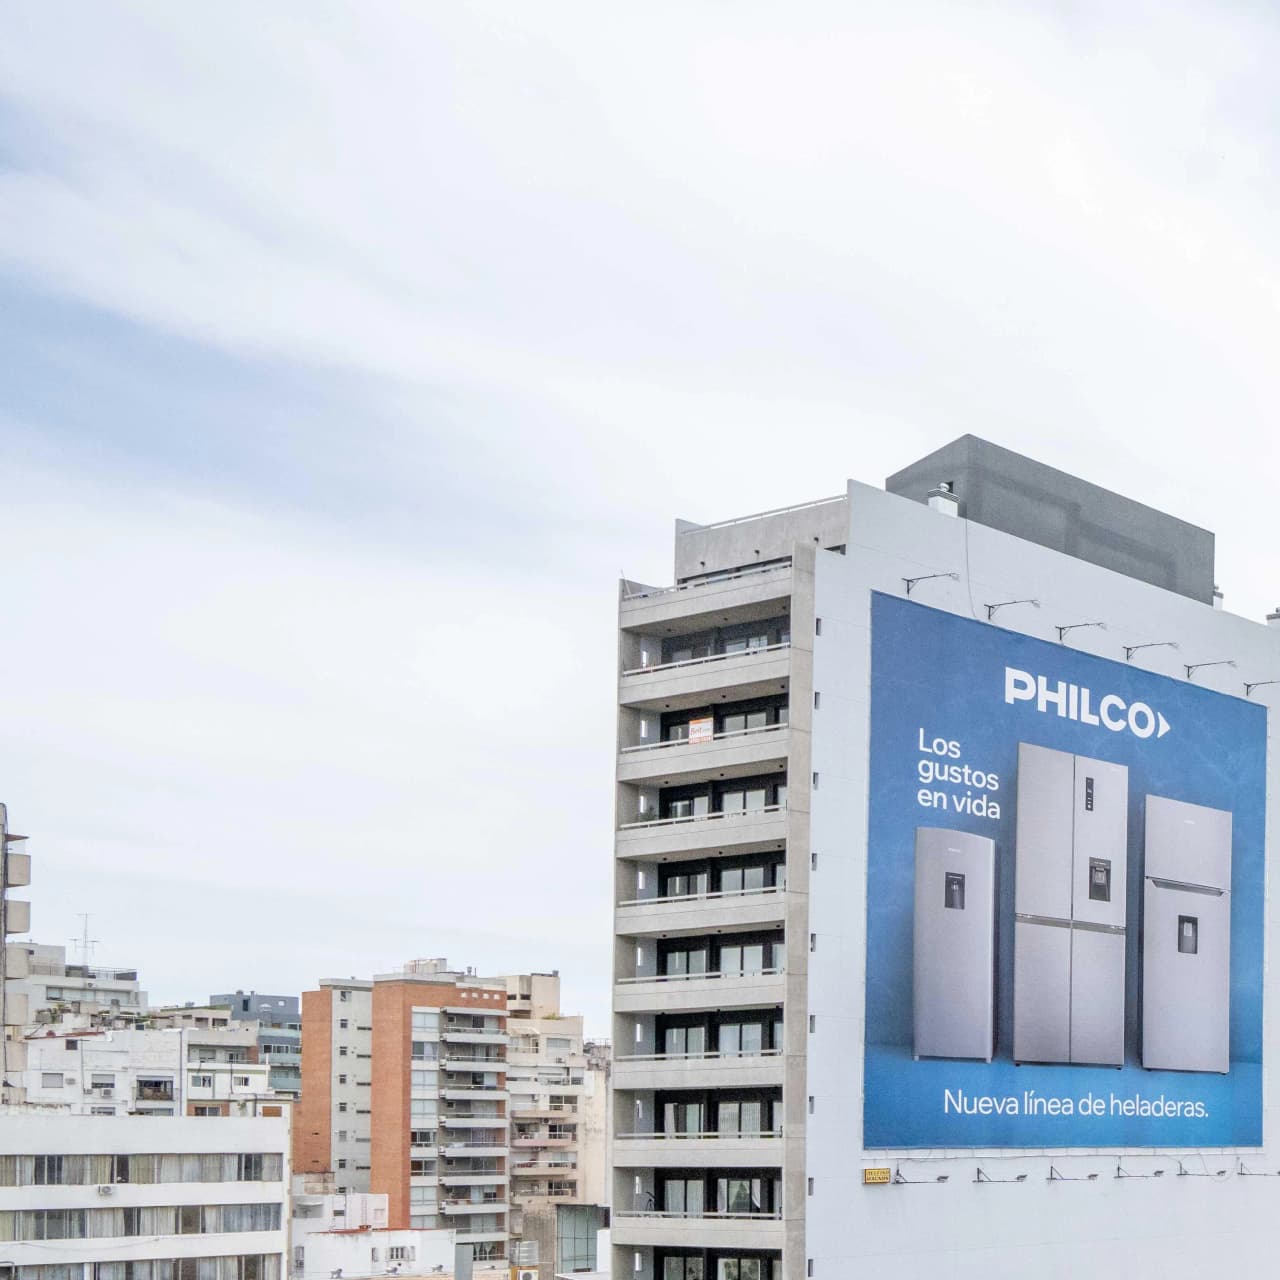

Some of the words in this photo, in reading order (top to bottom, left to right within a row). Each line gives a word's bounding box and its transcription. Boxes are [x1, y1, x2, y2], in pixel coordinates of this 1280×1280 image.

[1005, 666, 1156, 739] PHILCO
[919, 728, 960, 758] Los
[918, 760, 999, 790] gustos
[917, 789, 947, 810] en
[952, 791, 1000, 820] vida
[944, 1089, 1018, 1115] Nueva
[1024, 1090, 1073, 1116] línea
[1078, 1093, 1105, 1116] de
[1110, 1093, 1209, 1118] heladeras.
